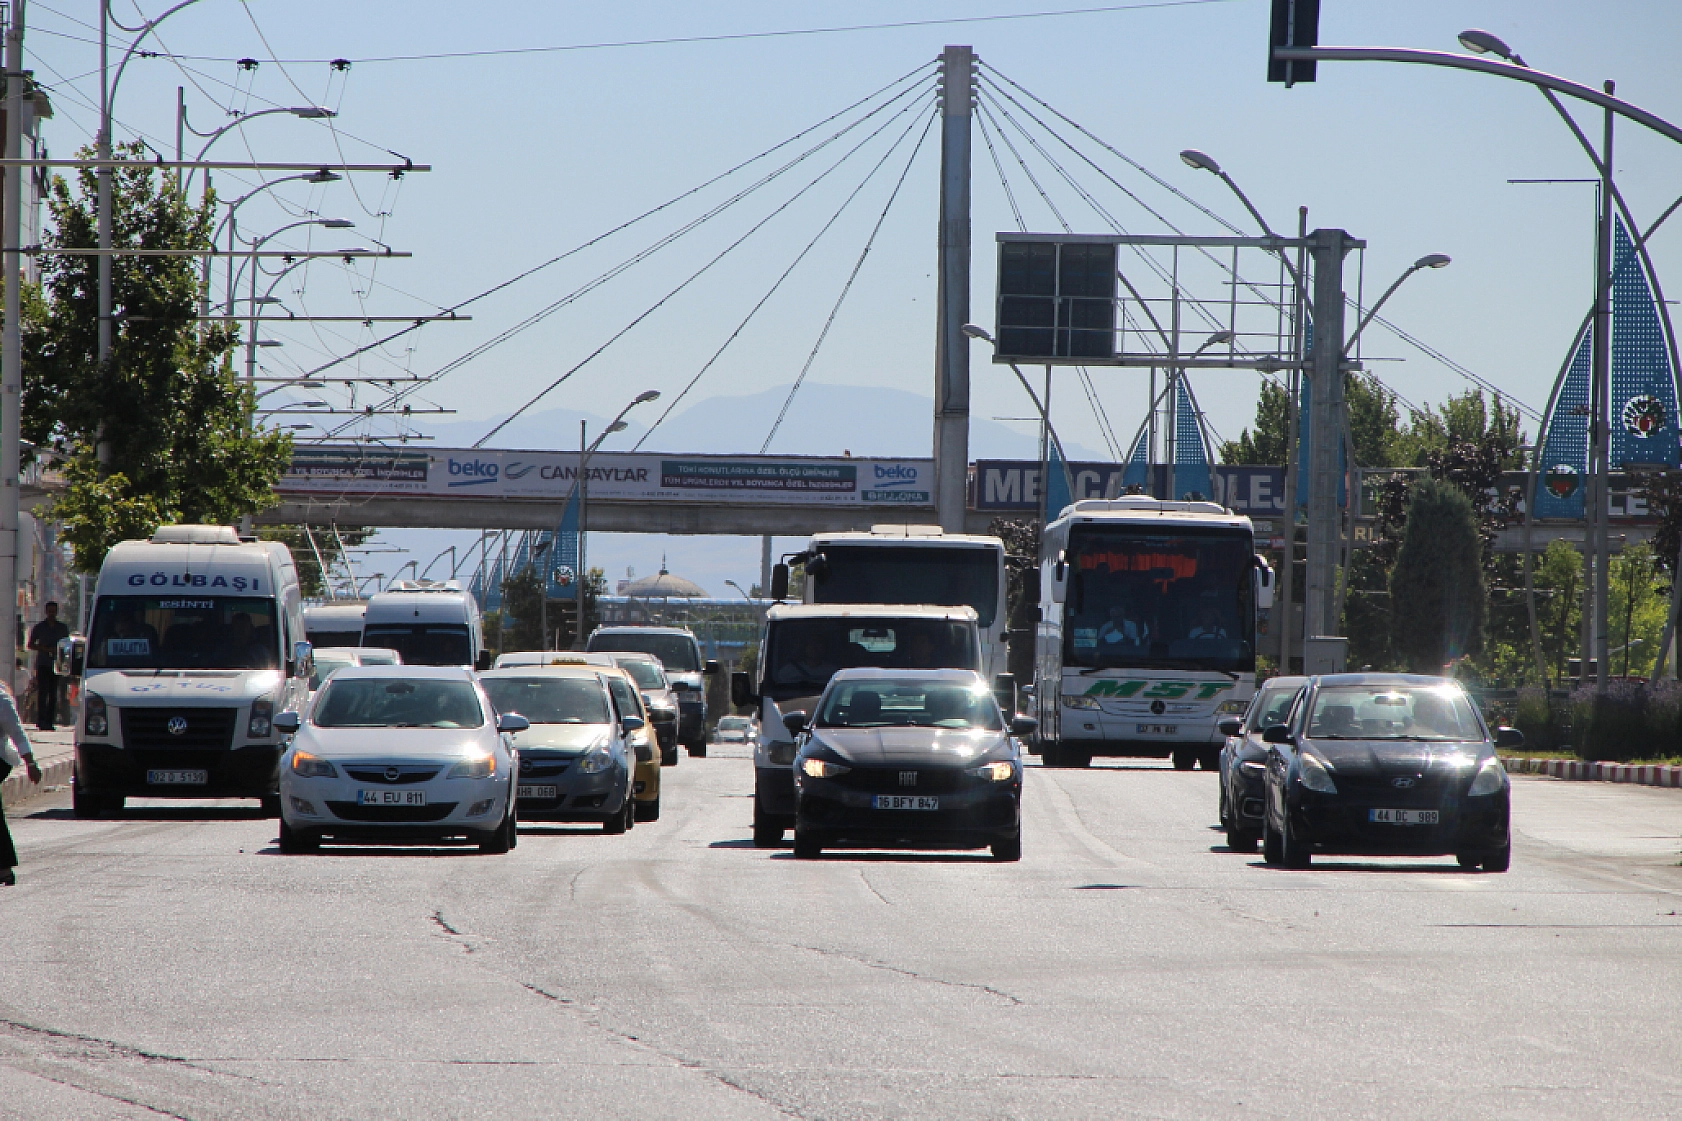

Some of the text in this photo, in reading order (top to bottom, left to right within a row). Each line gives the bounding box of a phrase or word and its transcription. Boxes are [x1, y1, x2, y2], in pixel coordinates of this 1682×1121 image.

[447, 458, 499, 477] beko
[873, 464, 918, 479] beko
[128, 571, 259, 592] GÖLBAŞI
[1083, 679, 1235, 700] MST
[898, 770, 918, 787] FIAT
[364, 791, 423, 804] 44 EU 811
[918, 797, 937, 809] 847
[1377, 810, 1390, 821] 44
